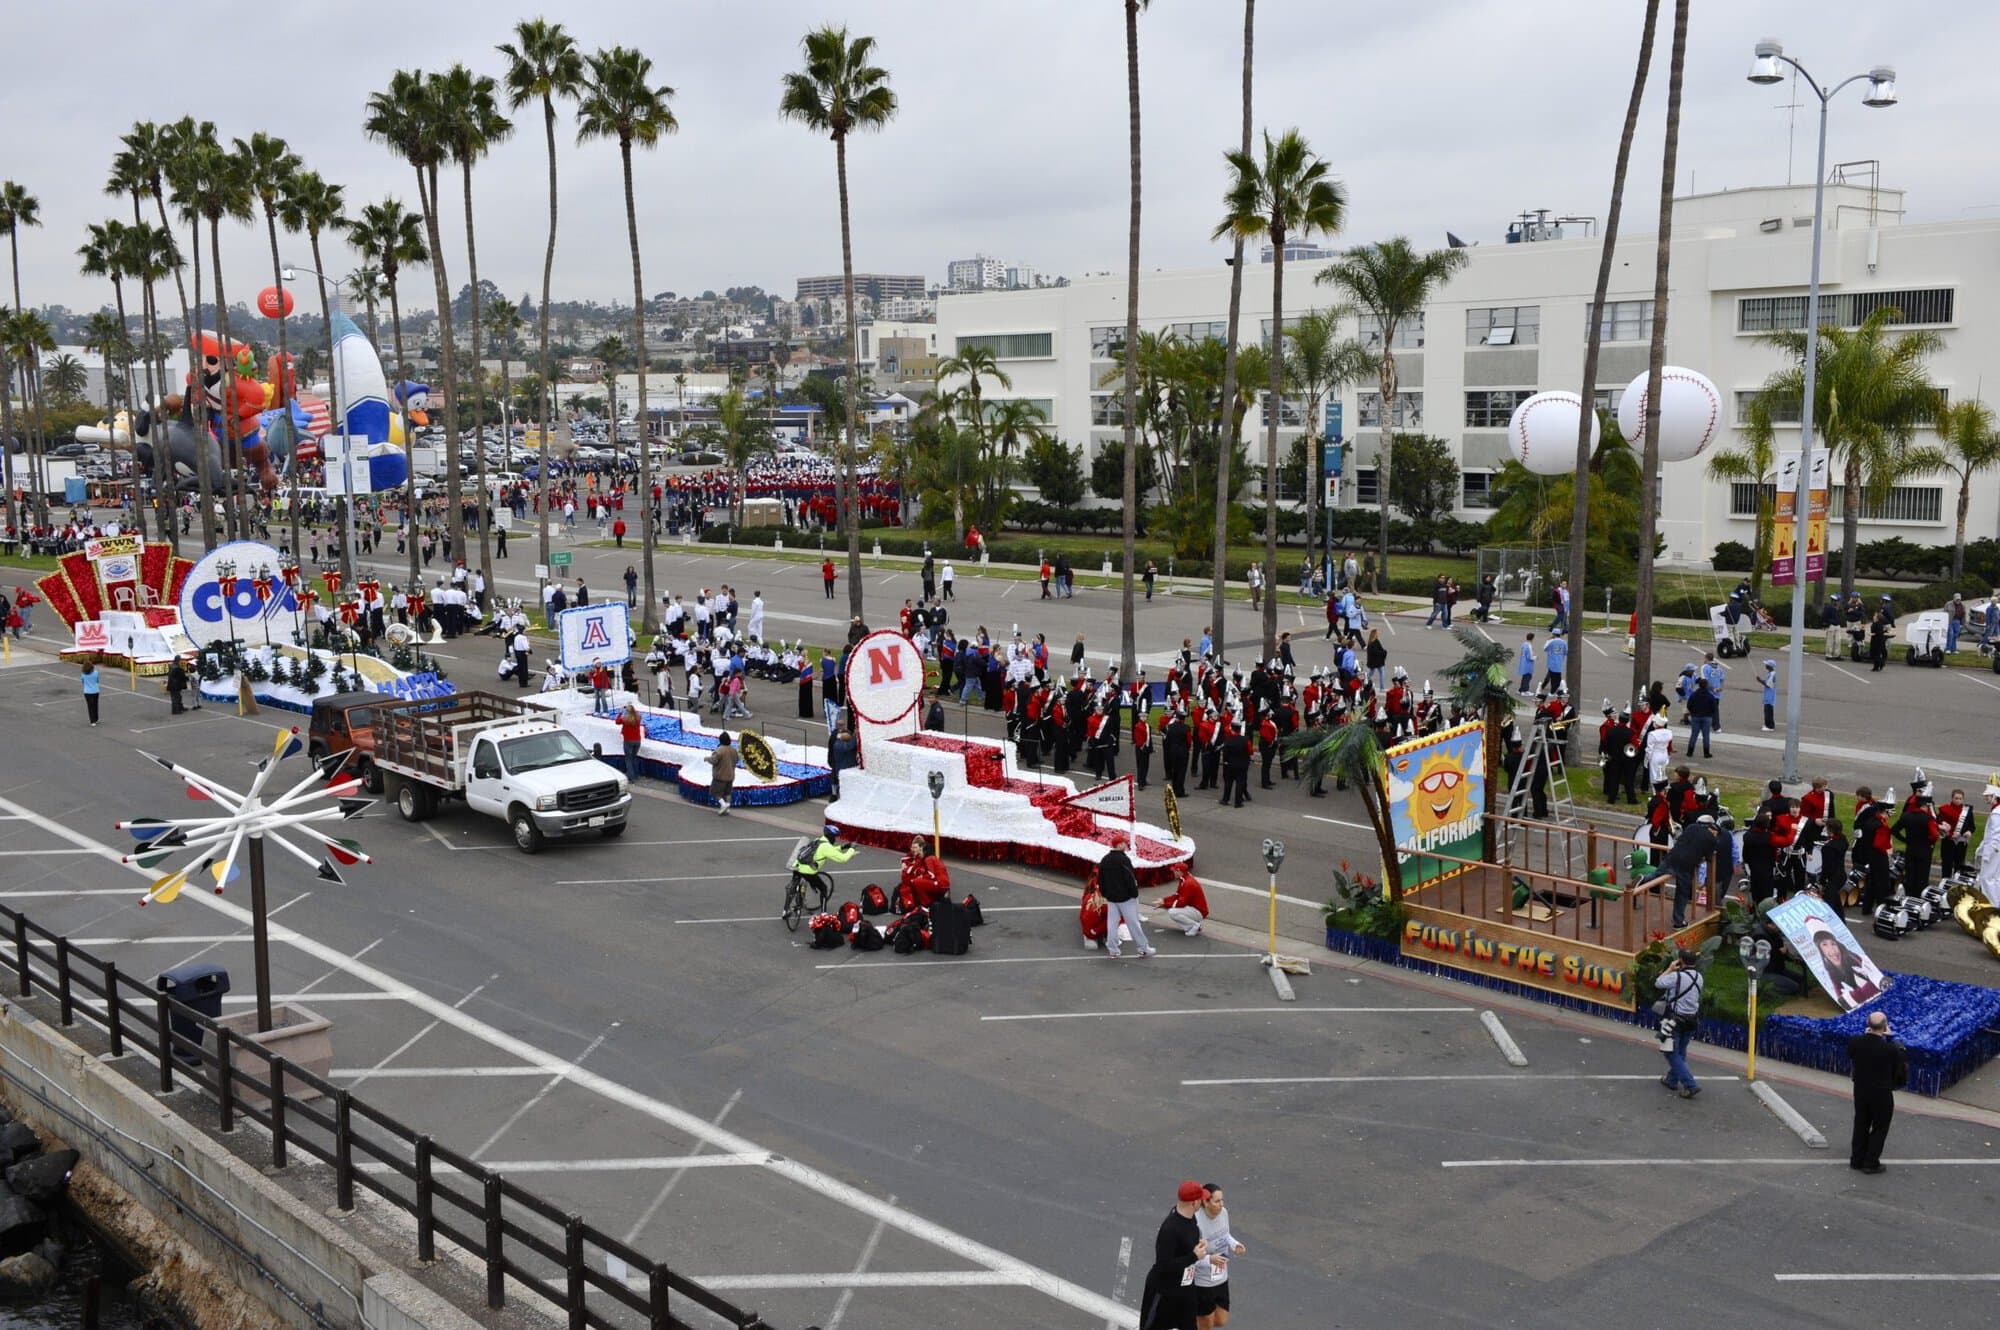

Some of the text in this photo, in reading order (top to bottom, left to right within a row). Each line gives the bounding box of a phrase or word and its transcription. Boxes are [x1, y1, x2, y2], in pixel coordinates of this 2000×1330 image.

[192, 575, 298, 622] COX
[582, 616, 611, 650] A
[868, 645, 902, 685] N
[1397, 813, 1483, 864] CALIFORNIA
[1406, 920, 1459, 953] FUN
[1498, 942, 1557, 978] THE
[1563, 954, 1624, 993] SUN
